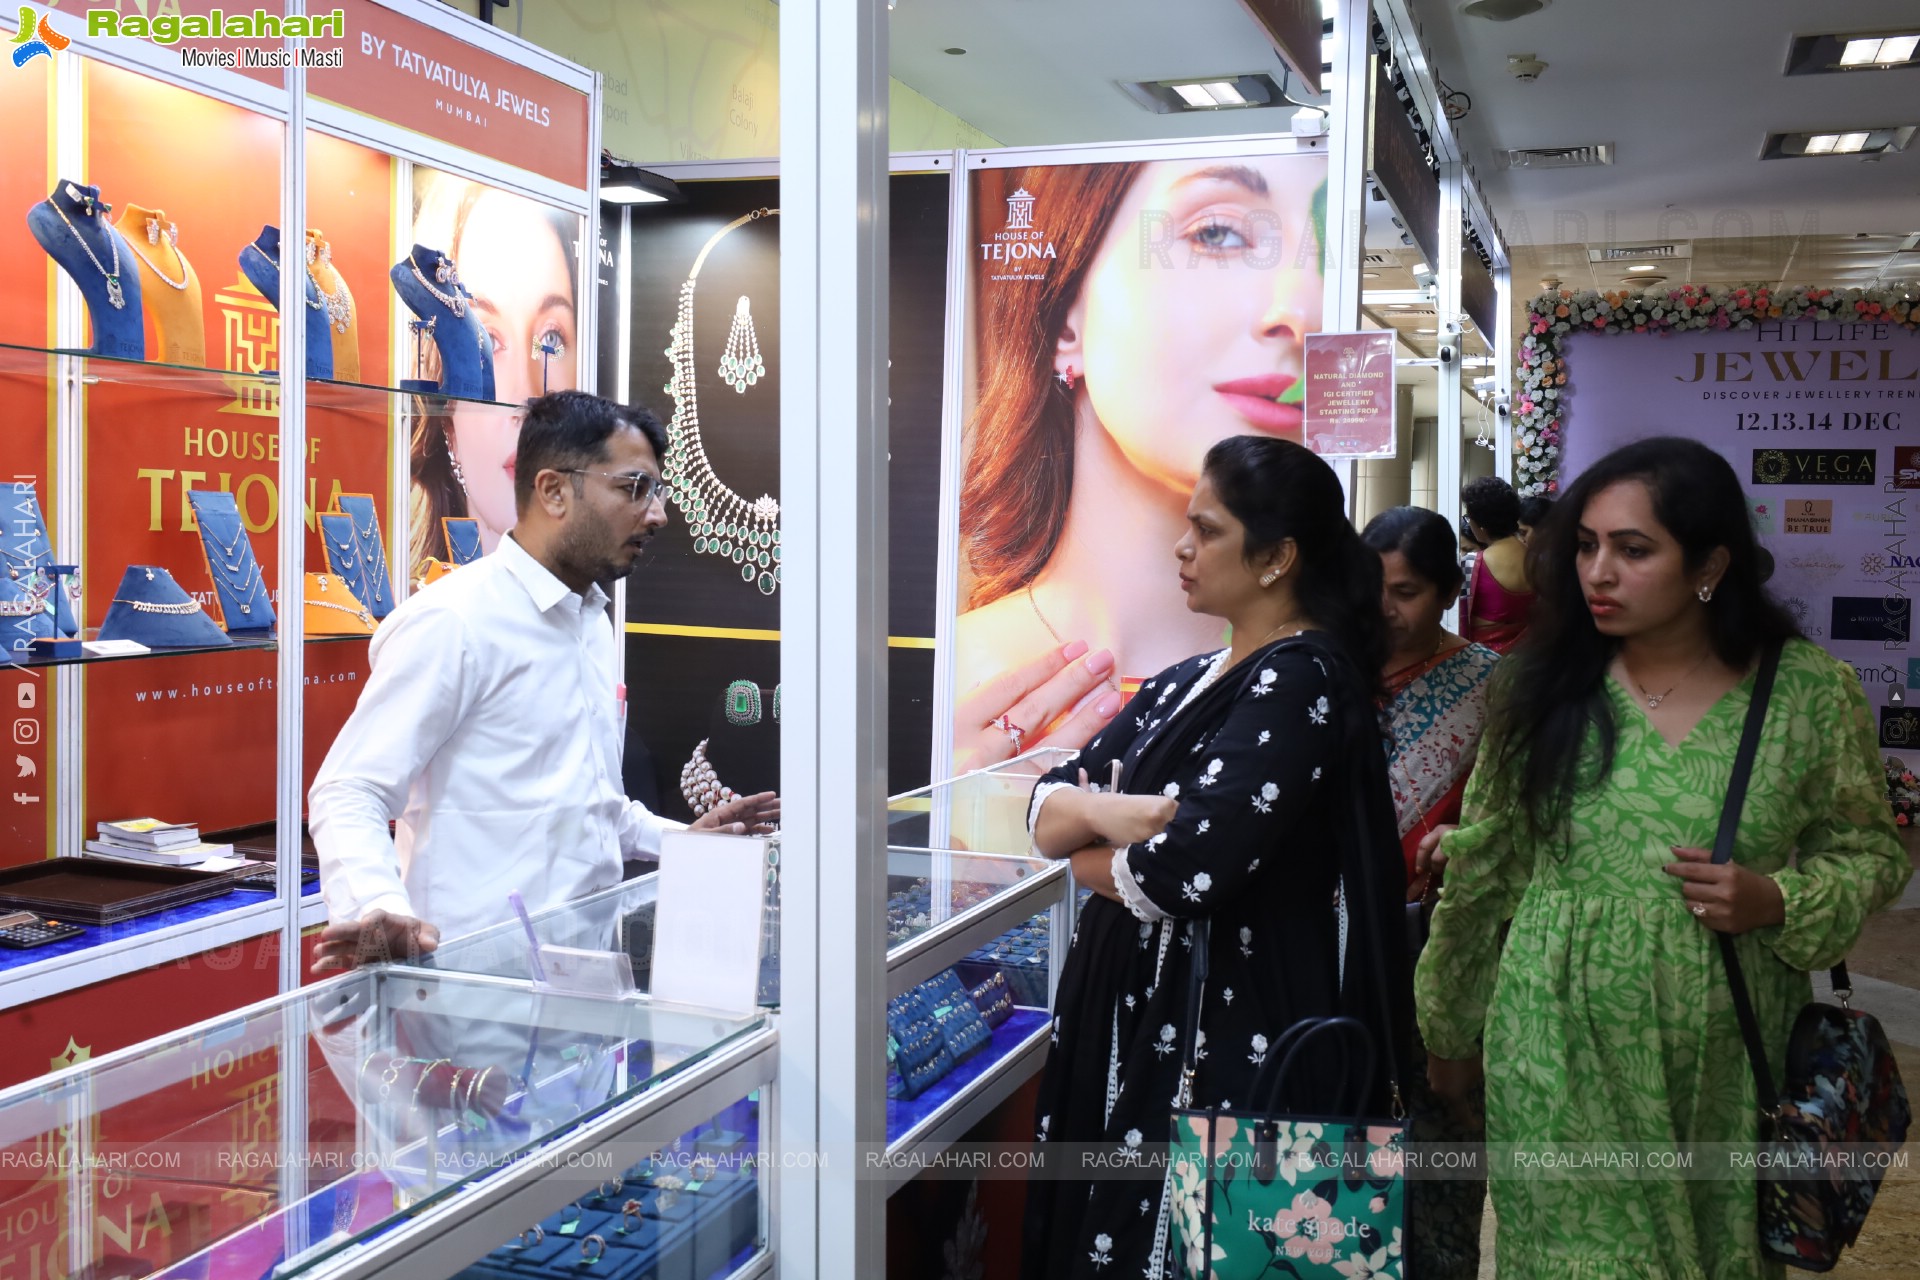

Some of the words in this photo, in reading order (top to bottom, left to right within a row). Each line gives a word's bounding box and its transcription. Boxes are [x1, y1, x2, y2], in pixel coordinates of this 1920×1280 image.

[361, 31, 386, 60] BY
[391, 44, 490, 103] TATVATULYA
[495, 88, 550, 127] JEWELS
[732, 83, 755, 109] Balaji
[436, 99, 487, 128] MUMBAI
[730, 108, 759, 137] Colony
[994, 232, 1028, 241] HOUSE
[1030, 231, 1045, 240] OF
[980, 242, 1057, 265] TEJONA
[1349, 371, 1384, 379] DIAMOND
[1703, 390, 1779, 400] DISCOVER
[1785, 390, 1871, 399] JEWELLERY
[1877, 389, 1920, 399] TREN
[1735, 411, 1833, 431] 12.13.14
[1841, 411, 1901, 431] DEC
[184, 426, 280, 462] HOUSE
[1795, 455, 1874, 473] VEGA
[1787, 524, 1799, 533] BE
[1802, 524, 1829, 533] TRUE
[1248, 1209, 1297, 1232] kate
[1303, 1216, 1372, 1243] spade
[1275, 1245, 1304, 1257] NEW
[1306, 1248, 1342, 1260] YORK
